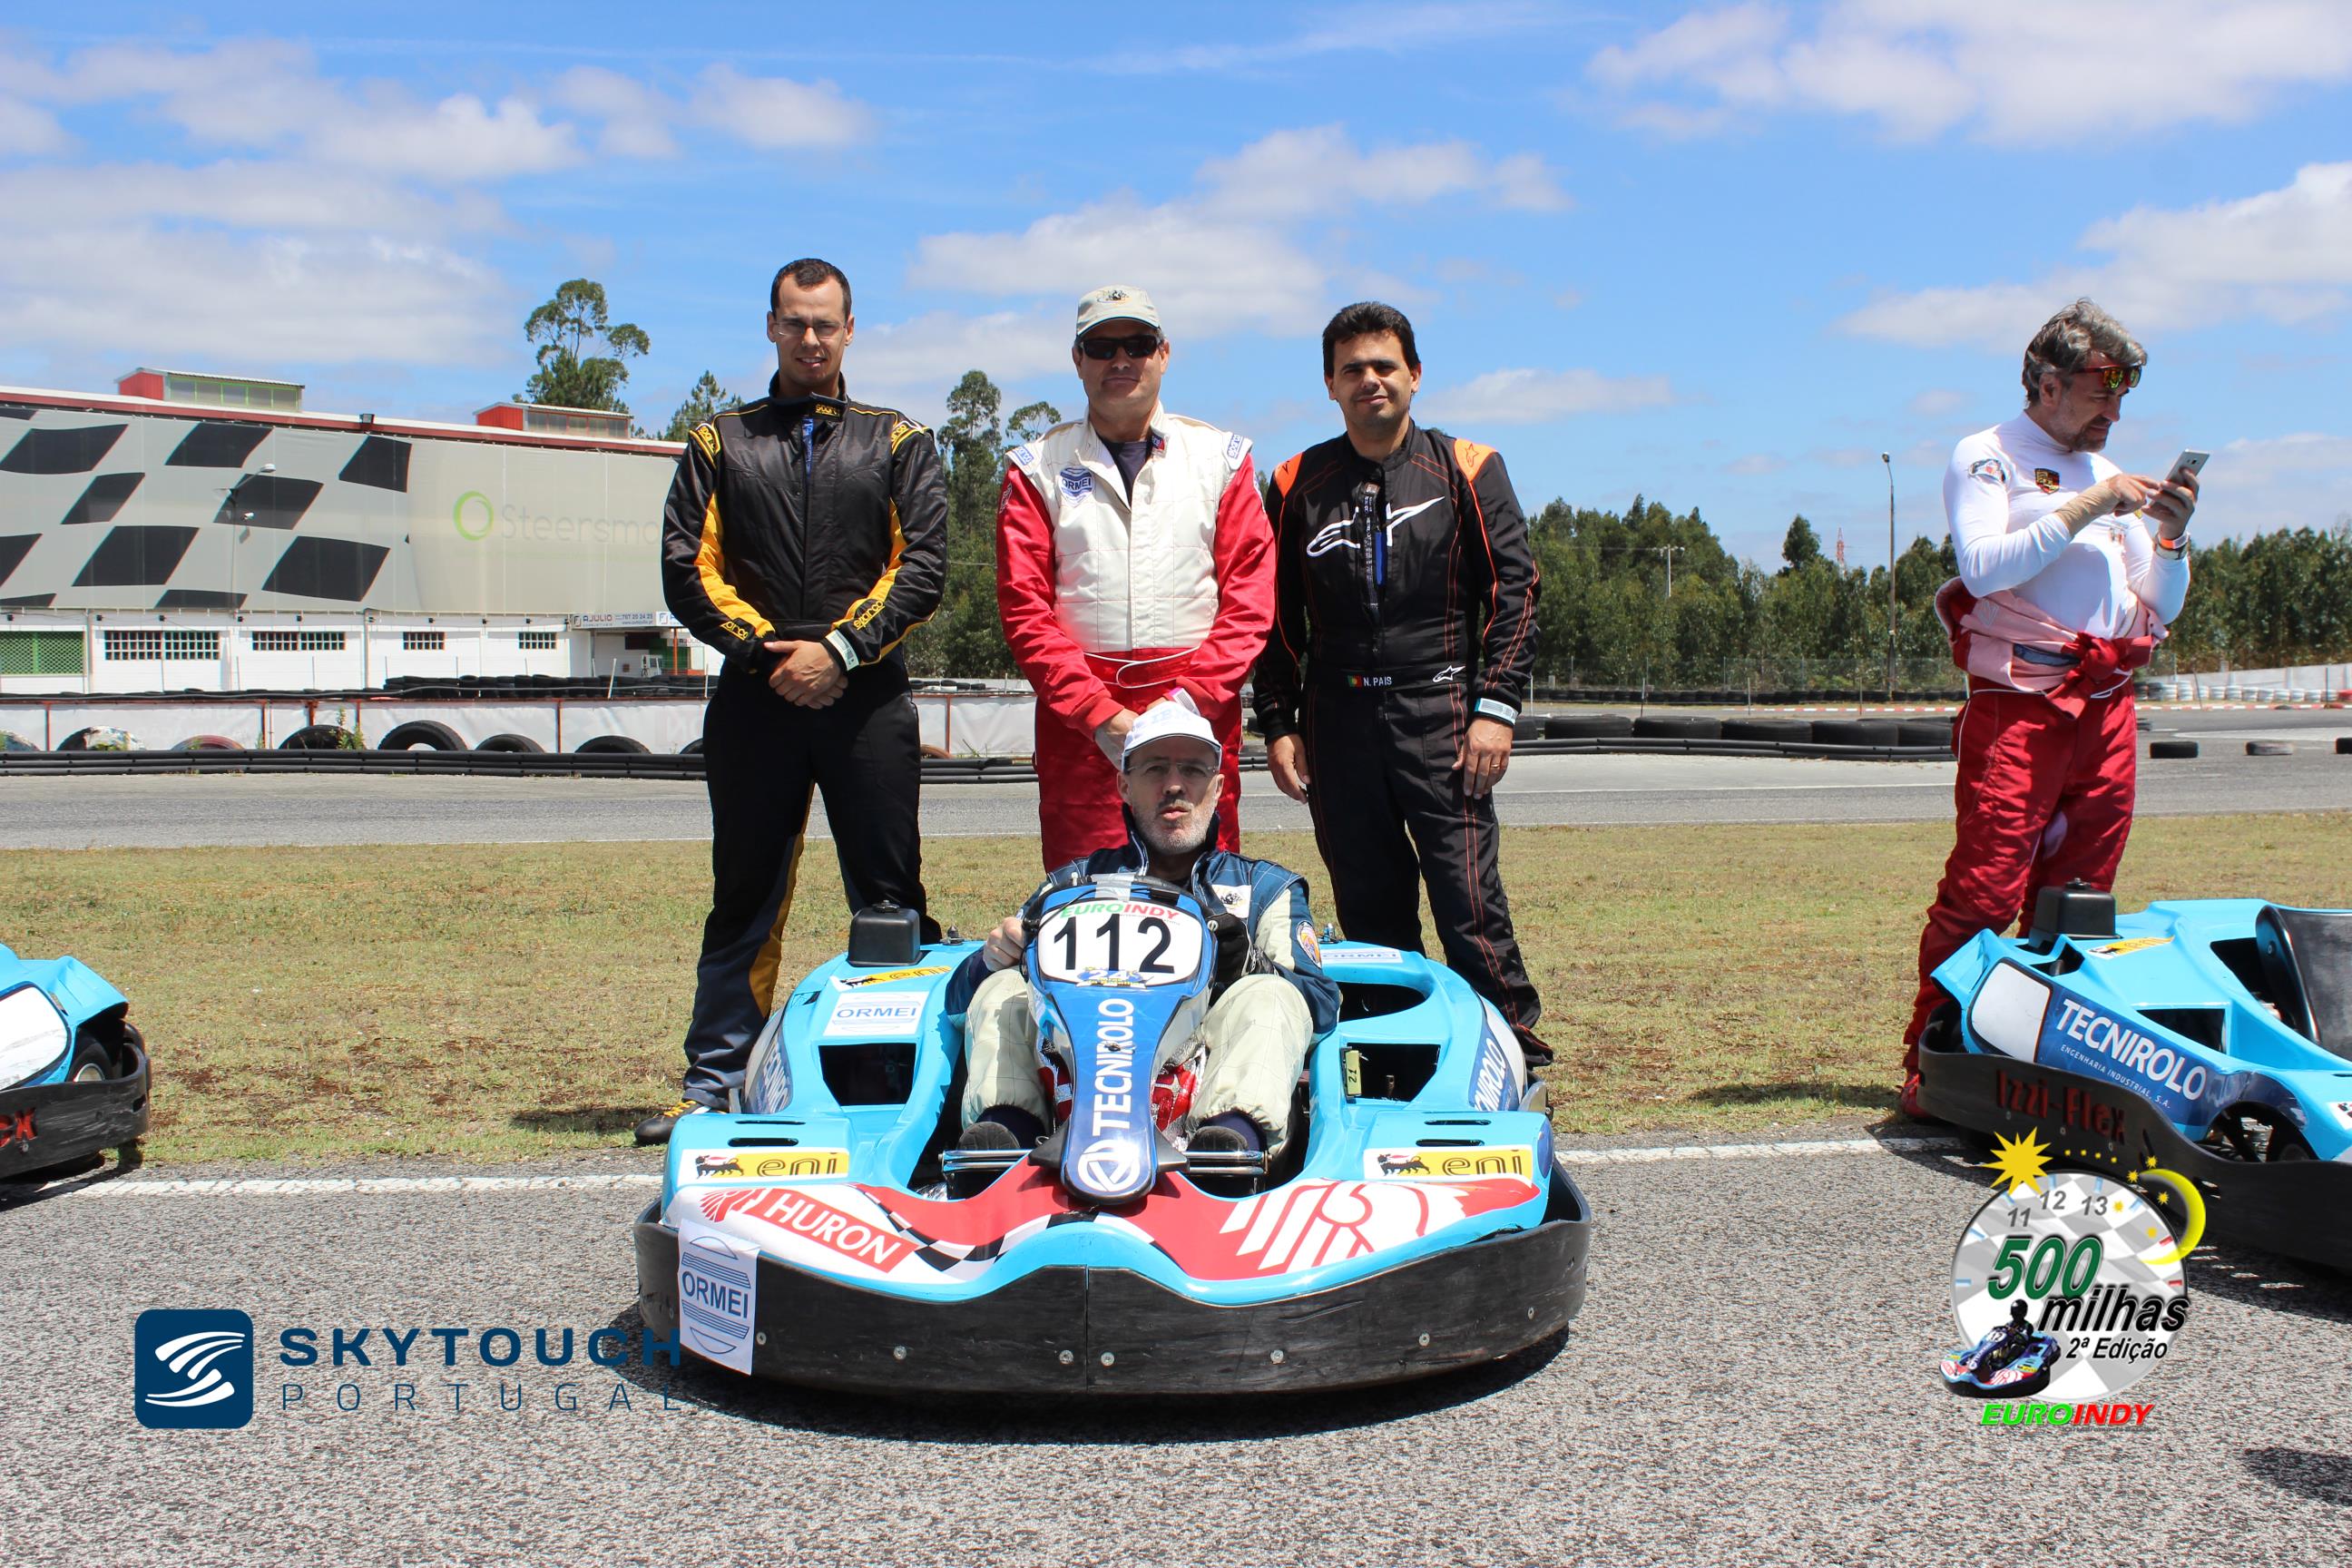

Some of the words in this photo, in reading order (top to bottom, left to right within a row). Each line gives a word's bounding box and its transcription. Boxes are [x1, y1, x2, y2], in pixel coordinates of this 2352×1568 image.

[1062, 477, 1092, 490] ORMEI
[1363, 676, 1372, 687] N.
[1373, 676, 1392, 687] PAIS
[1060, 902, 1180, 918] EUROINDY
[1054, 913, 1175, 975] 112
[837, 1007, 916, 1018] ORMEI
[1092, 998, 1135, 1137] TECNIROLO
[2056, 998, 2208, 1101] TECNIROLO
[2060, 1044, 2106, 1073] ENGENHARIA
[2154, 1094, 2171, 1109] S.A.
[757, 1152, 838, 1178] eni
[1442, 1149, 1523, 1176] eni
[764, 1192, 901, 1265] HURON
[681, 1270, 750, 1319] ORMEI
